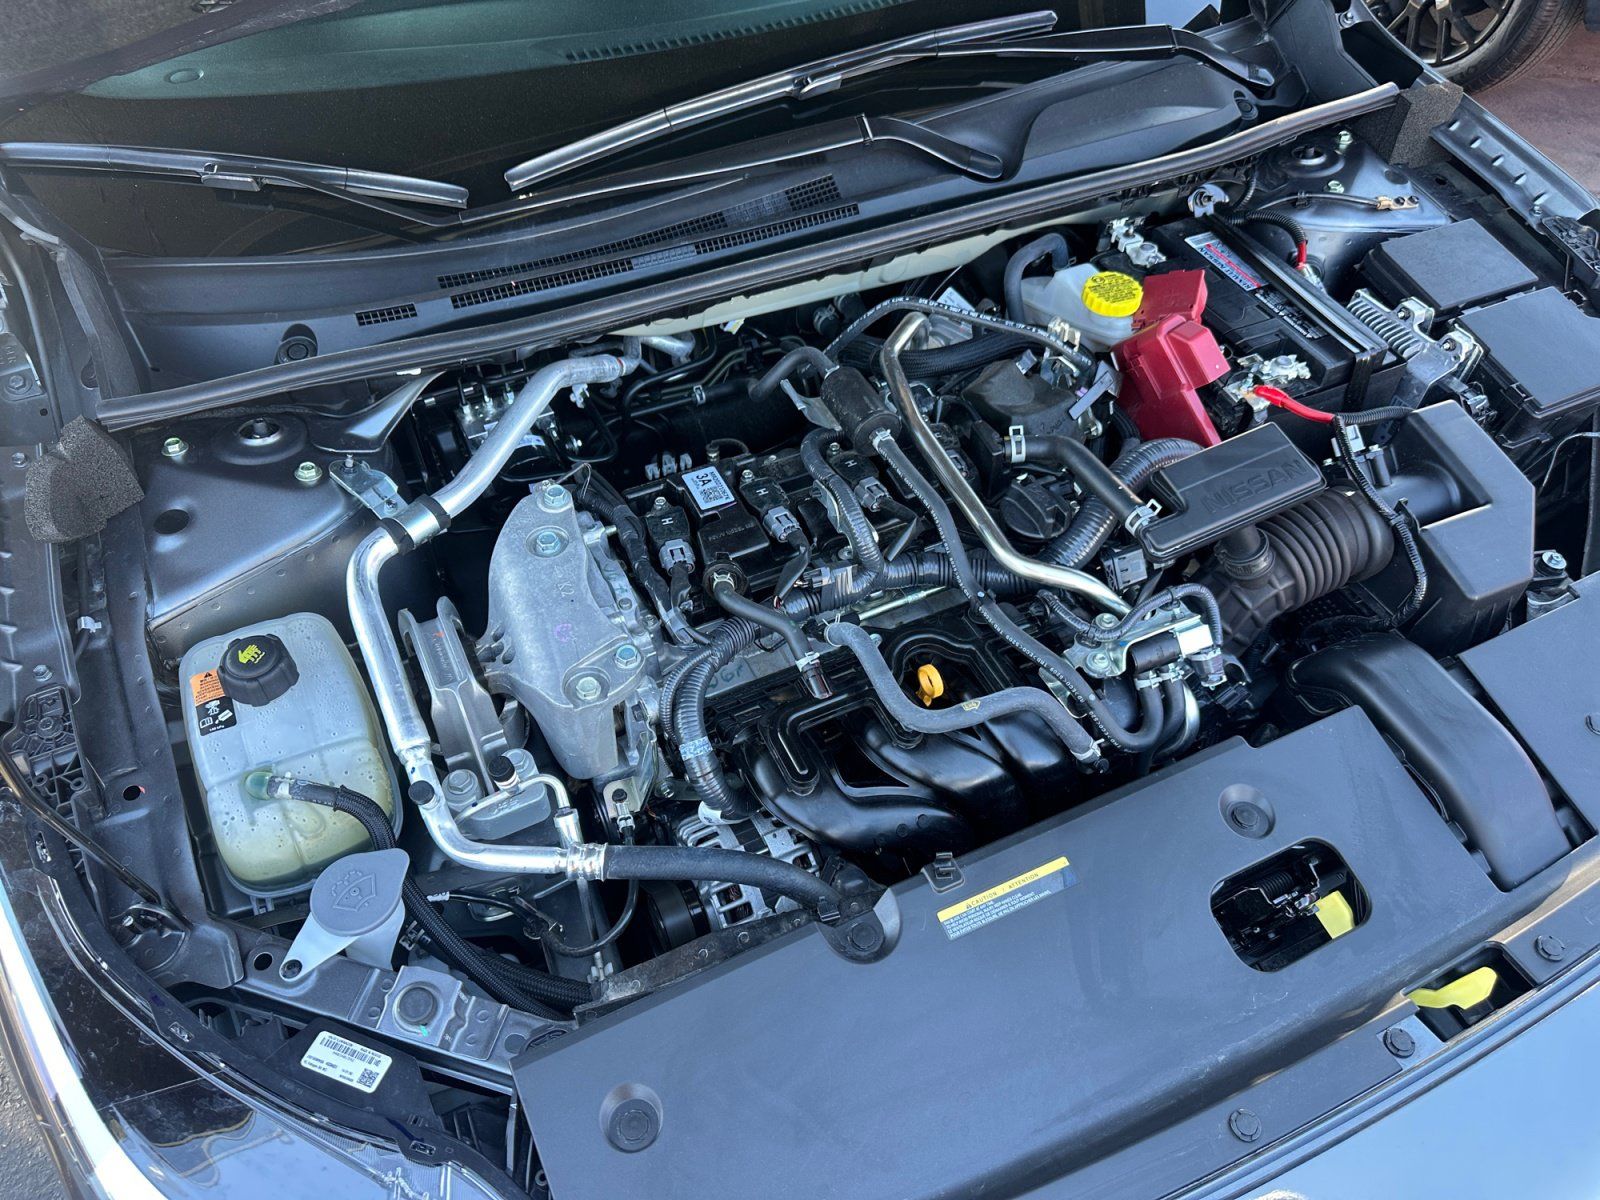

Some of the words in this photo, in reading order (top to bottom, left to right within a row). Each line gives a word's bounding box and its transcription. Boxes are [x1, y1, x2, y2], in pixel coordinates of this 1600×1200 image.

[696, 473, 712, 487] 3A
[1201, 459, 1308, 513] NISSAN
[971, 891, 998, 907] CAUTION
[1008, 873, 1039, 889] ATTENTION
